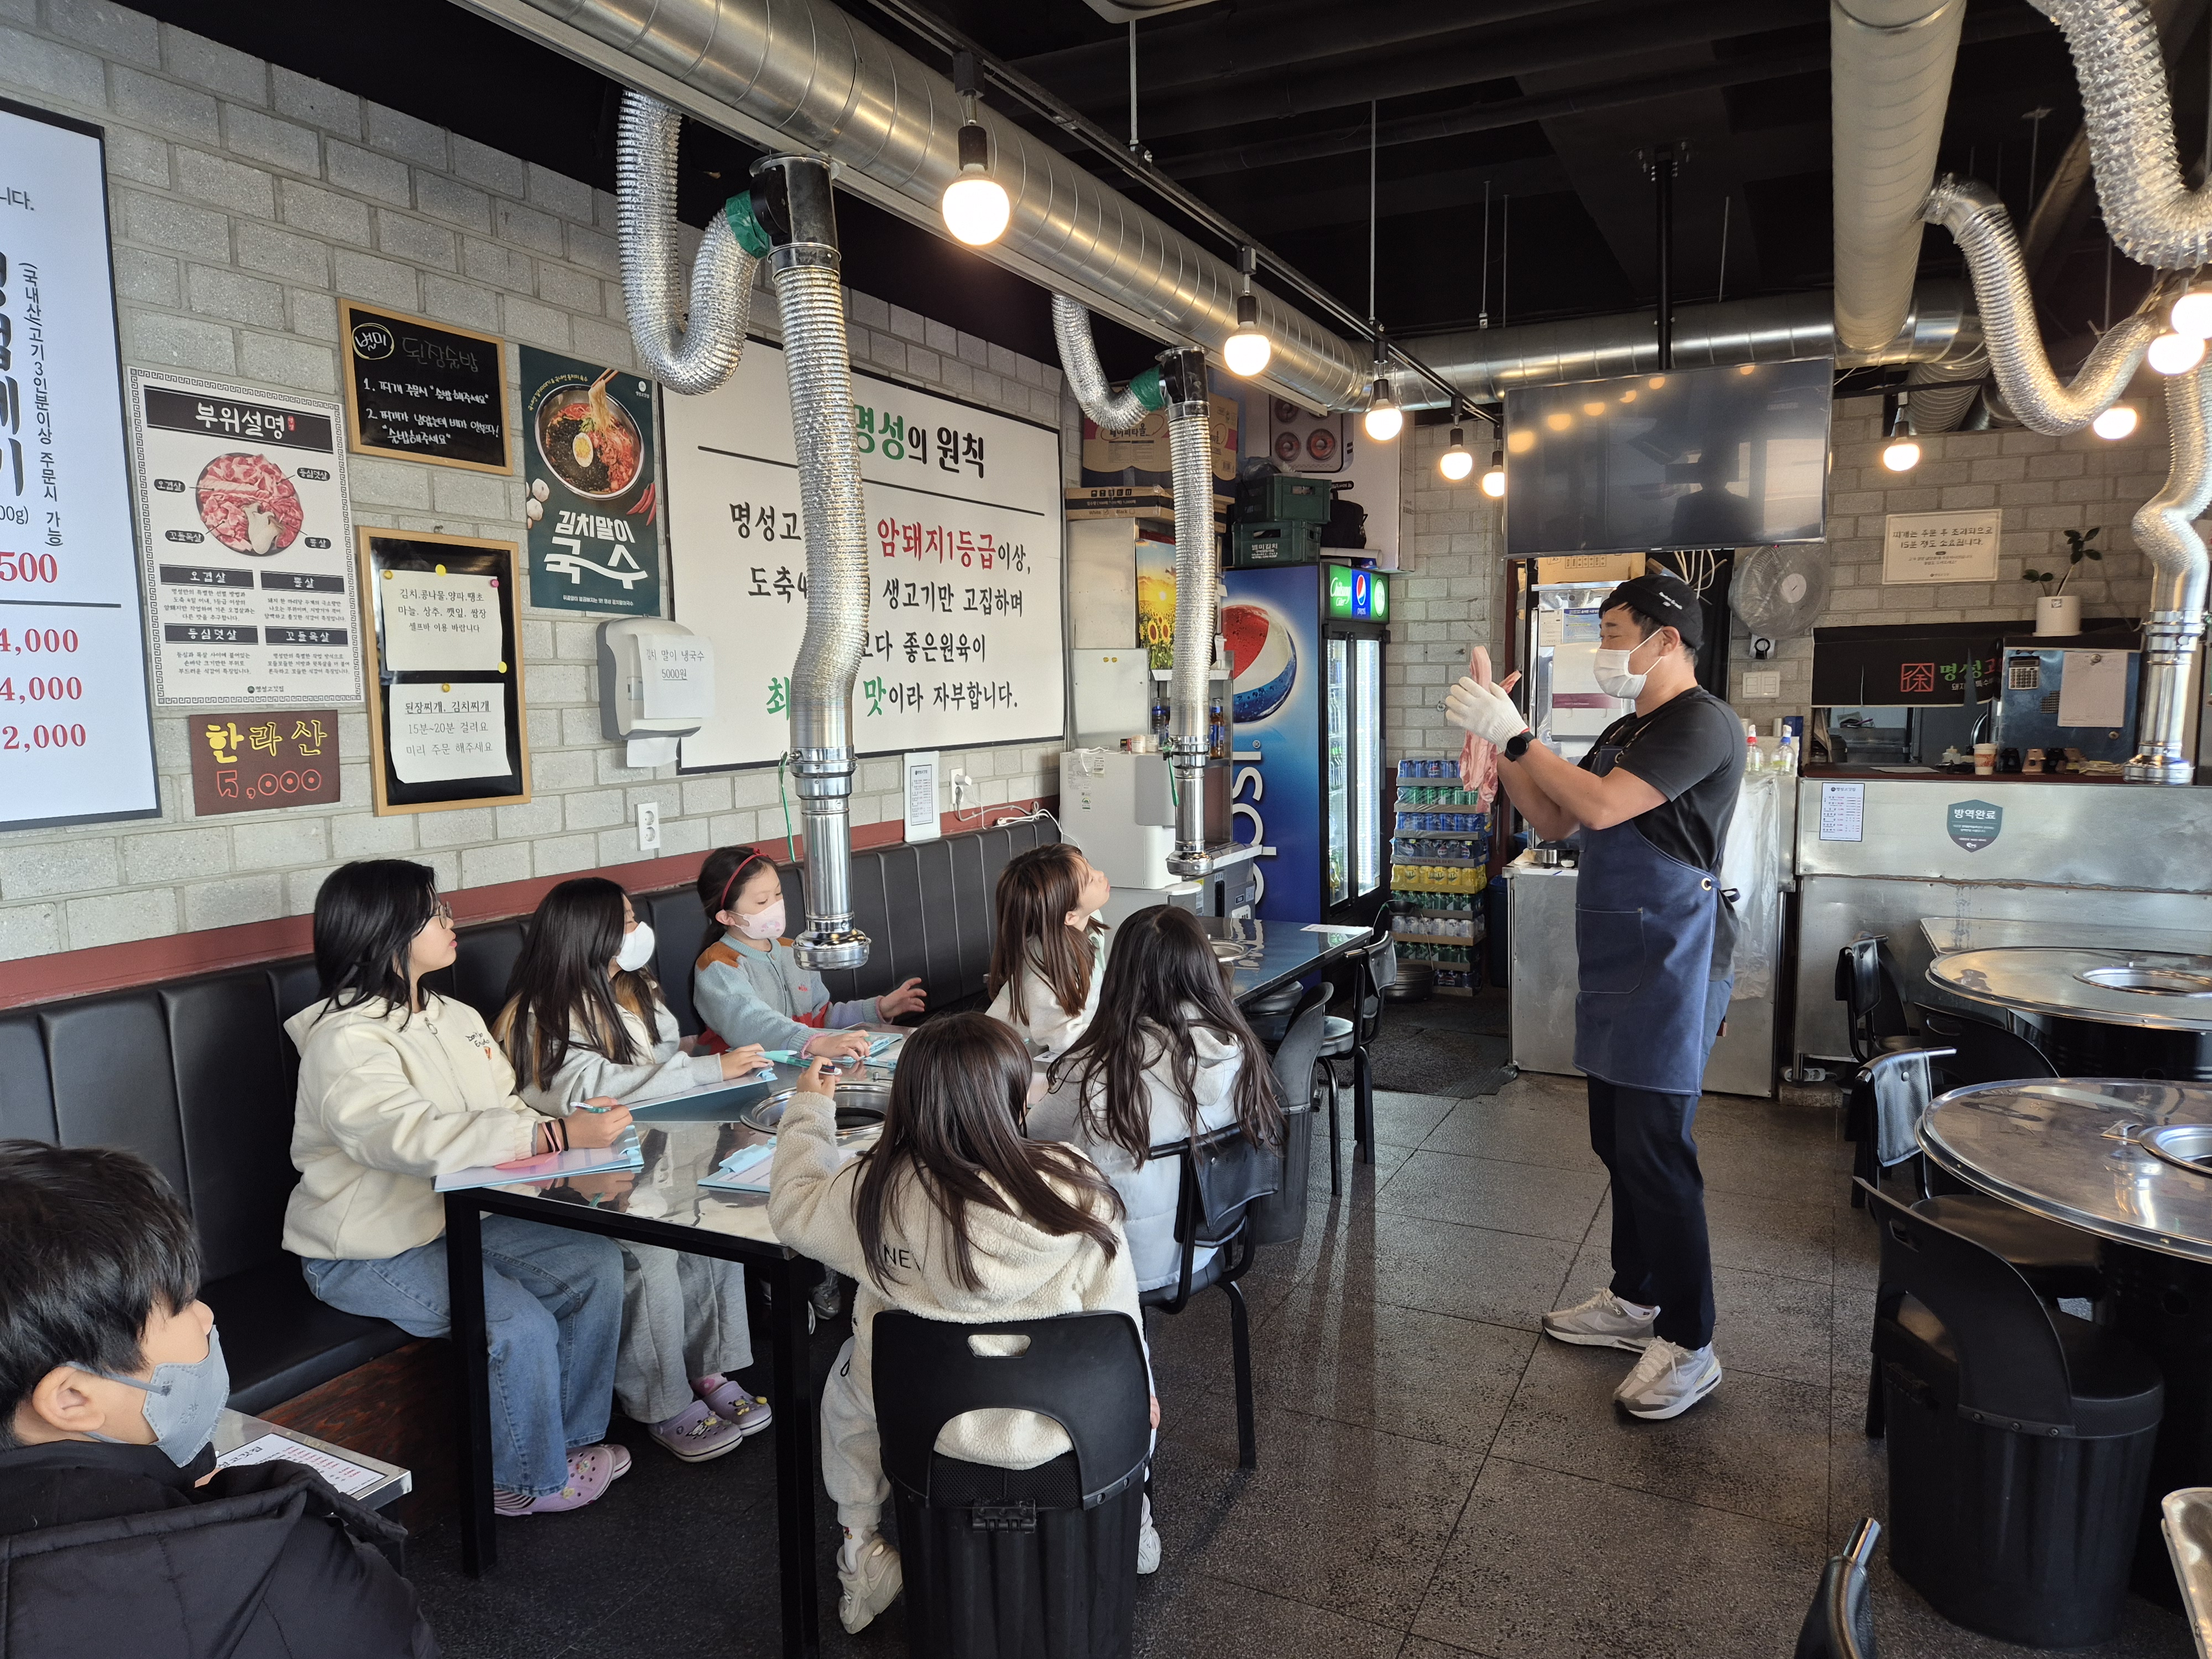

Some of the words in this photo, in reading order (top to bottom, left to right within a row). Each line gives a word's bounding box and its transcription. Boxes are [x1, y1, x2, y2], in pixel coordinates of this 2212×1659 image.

[378, 381, 403, 394] 찌개
[405, 383, 428, 398] 주문시
[195, 401, 285, 440] 부위설명
[937, 426, 984, 479] 원칙
[40, 452, 57, 502] 주문시
[158, 481, 182, 492] 오겹살
[45, 511, 63, 546] 가능)
[555, 510, 635, 543] 김치말이
[729, 502, 802, 542] 명성고
[1892, 530, 1918, 538] 찌개는
[1921, 529, 1937, 537] 주문
[1901, 540, 1917, 549] 15분
[1920, 540, 1937, 548] 정도
[544, 536, 648, 589] 국수
[190, 571, 226, 583] 오겹살
[883, 578, 954, 613] 생고기만
[963, 587, 1023, 617] 고집하며
[471, 608, 487, 619] 쌈장
[188, 628, 237, 640] 등심덧살
[409, 622, 430, 631] 셀프바
[434, 623, 448, 632] 이용
[452, 623, 480, 633] 바랍니다
[661, 650, 676, 661] 말이
[681, 651, 705, 662] 냉국수
[661, 669, 687, 680] 5000원
[863, 676, 923, 717] 맛이라
[933, 681, 1018, 713] 자부합니다.
[452, 701, 489, 712] 김치찌개
[409, 722, 455, 735] 15분~20분
[461, 721, 488, 733] 걸려요
[2, 723, 86, 753] 2,000
[206, 719, 327, 763] 한라산
[406, 744, 425, 757] 미리
[431, 744, 450, 755] 주문
[456, 742, 492, 753] 해주세요
[216, 769, 321, 799] 5,000
[1954, 809, 1995, 819] 방역완료
